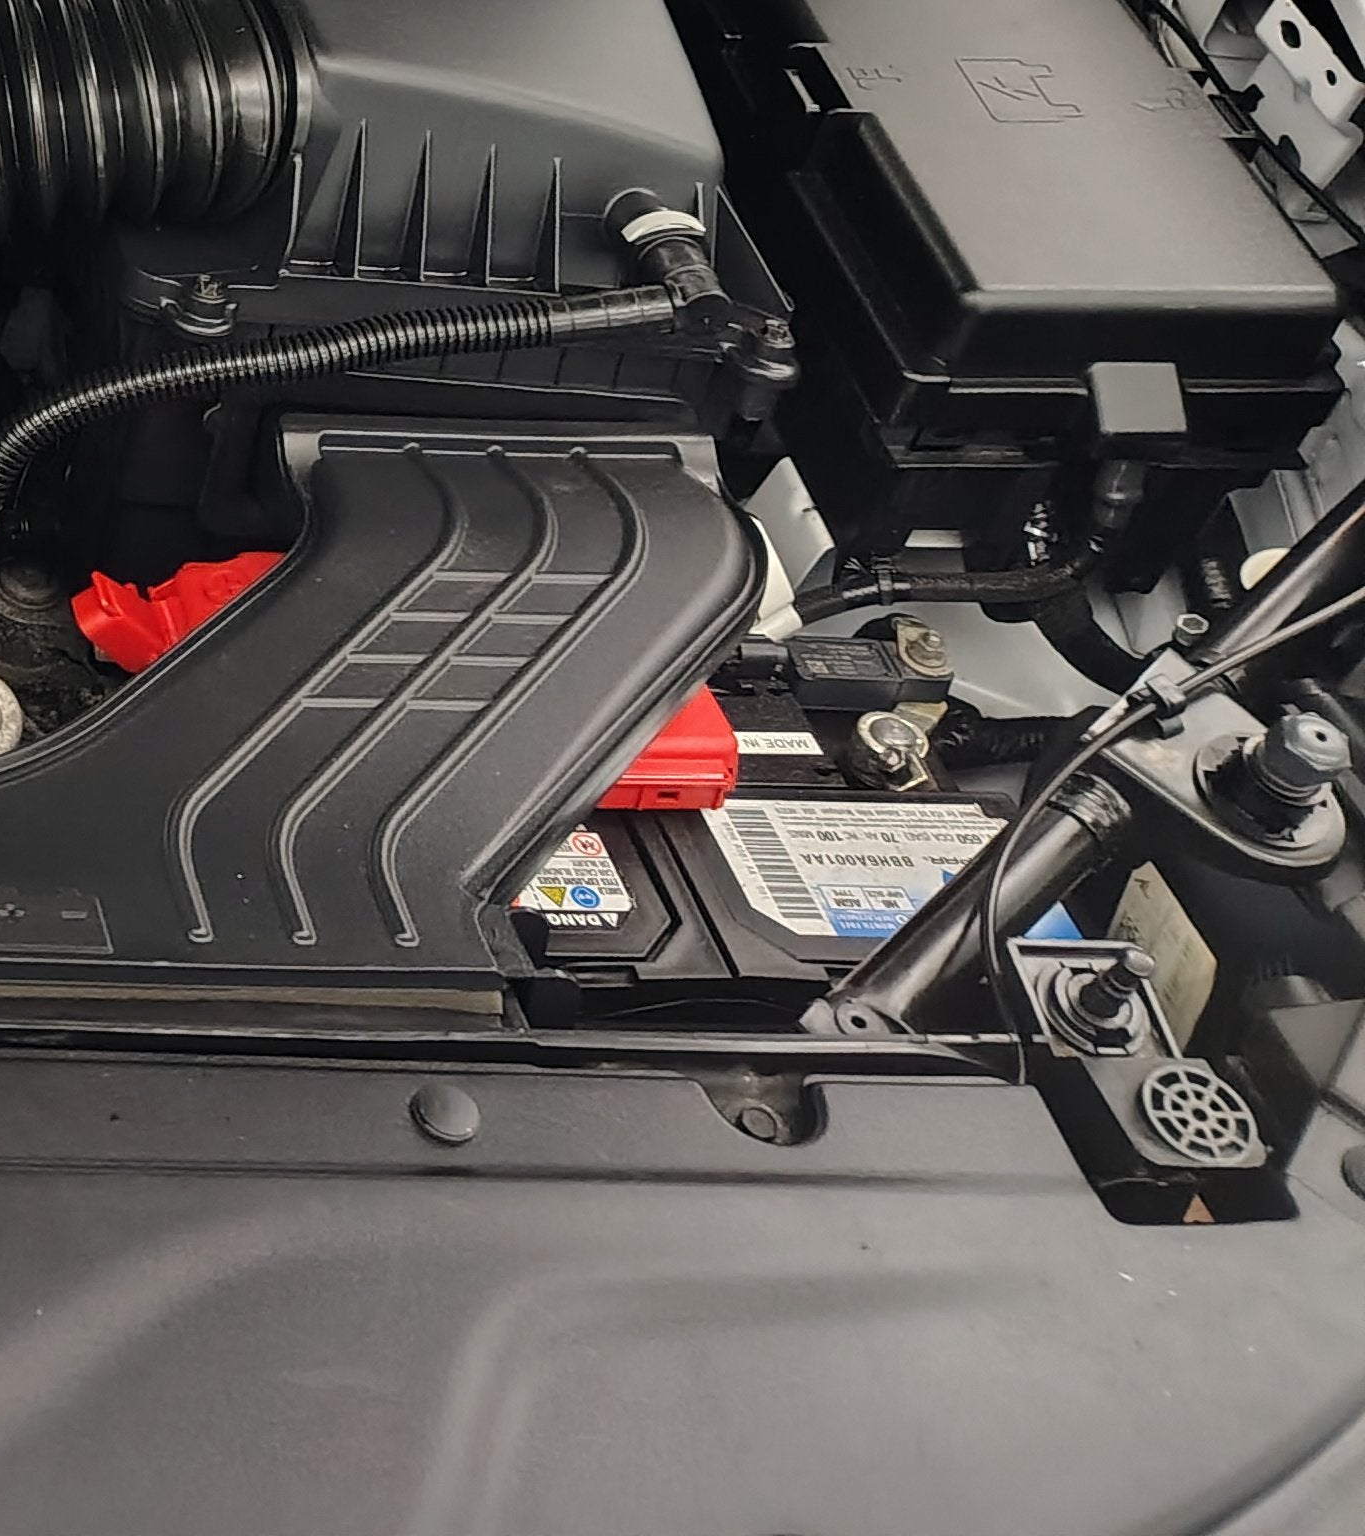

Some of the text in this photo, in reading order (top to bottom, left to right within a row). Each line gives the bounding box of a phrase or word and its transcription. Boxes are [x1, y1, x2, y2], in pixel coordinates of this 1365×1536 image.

[742, 737, 810, 749] MADE IN
[819, 830, 843, 841] 100
[881, 832, 900, 843] 70
[956, 834, 982, 844] 650
[799, 852, 915, 867] BBH6A001AA
[835, 898, 862, 908] AGM
